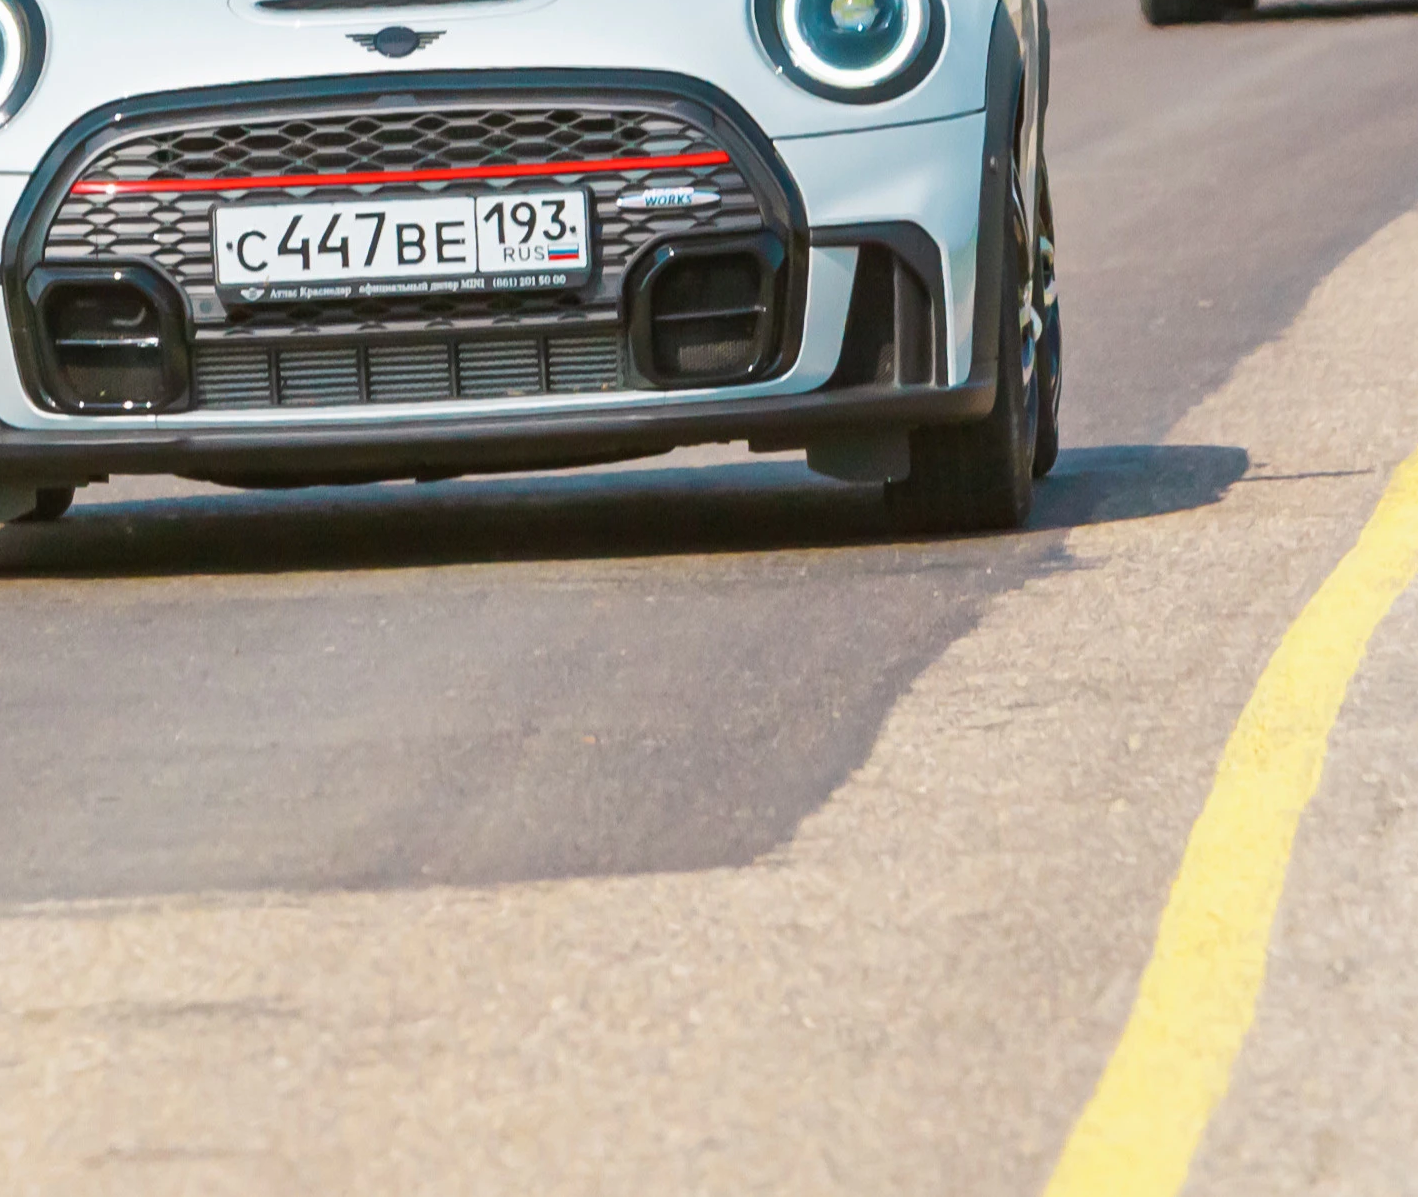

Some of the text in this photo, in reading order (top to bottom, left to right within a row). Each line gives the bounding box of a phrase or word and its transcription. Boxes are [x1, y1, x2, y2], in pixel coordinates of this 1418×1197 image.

[645, 194, 692, 207] WORKS
[483, 199, 567, 245] 193
[503, 245, 545, 262] RUS
[299, 285, 352, 300] Краснодар
[358, 281, 428, 296] официальный
[460, 278, 485, 289] MINI
[519, 275, 536, 287] 201
